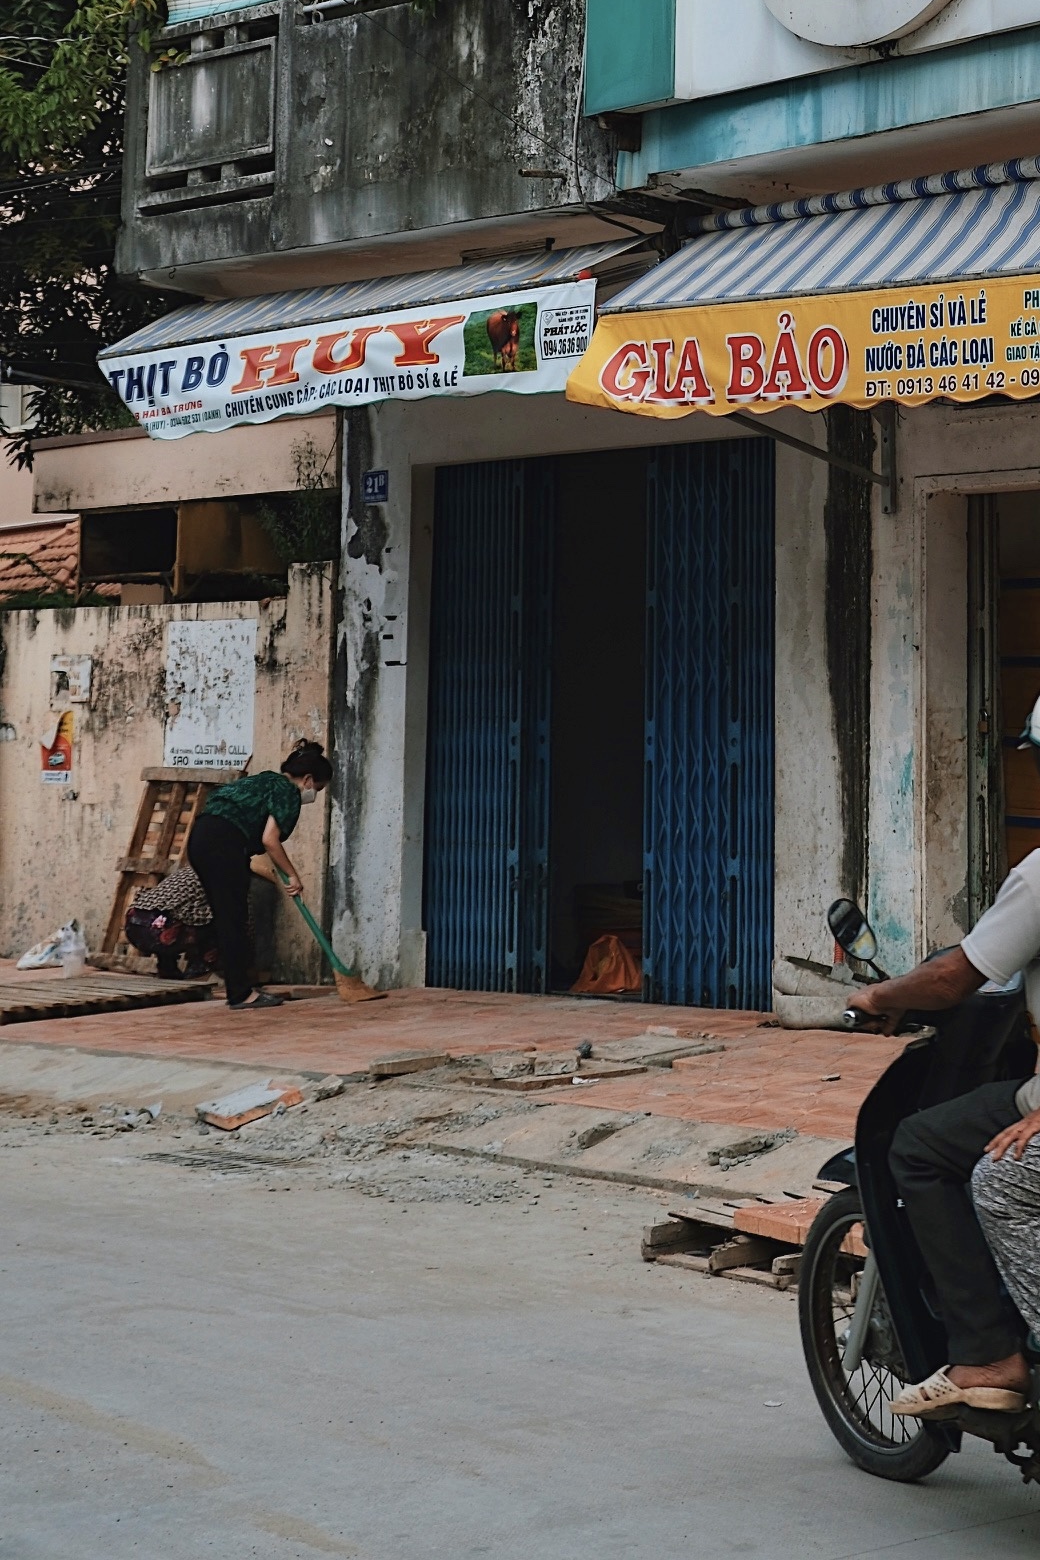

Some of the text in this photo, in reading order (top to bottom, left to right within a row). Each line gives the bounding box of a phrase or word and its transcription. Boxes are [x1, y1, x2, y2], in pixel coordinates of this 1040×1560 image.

[872, 289, 986, 334] CHUYÊN SỈ VÀ LẺ
[543, 324, 570, 337] PHÁT
[1024, 316, 1037, 336] CẢ
[107, 315, 466, 408] THỊT BÒ HUY
[598, 309, 850, 405] GIA BẢO
[865, 336, 994, 372] NƯỚC ĐÁ CÁC LOẠI
[1006, 345, 1027, 361] GIAO
[225, 395, 265, 418] CHUYÊN
[265, 392, 295, 411] CUNG
[319, 378, 336, 399] CÁC
[337, 377, 369, 397] LOẠI
[373, 375, 396, 395] THỊT
[398, 370, 414, 390] BÒ
[416, 367, 430, 389] SỈ
[432, 372, 441, 388] &
[444, 365, 458, 387] LẺ
[866, 380, 891, 397] ĐT:
[896, 377, 933, 396] 0913
[938, 374, 957, 392] 46
[962, 373, 979, 391] 41
[986, 371, 1005, 389] 42
[142, 409, 159, 419] HAI
[161, 405, 172, 416] BÀ
[228, 745, 248, 755] CALL
